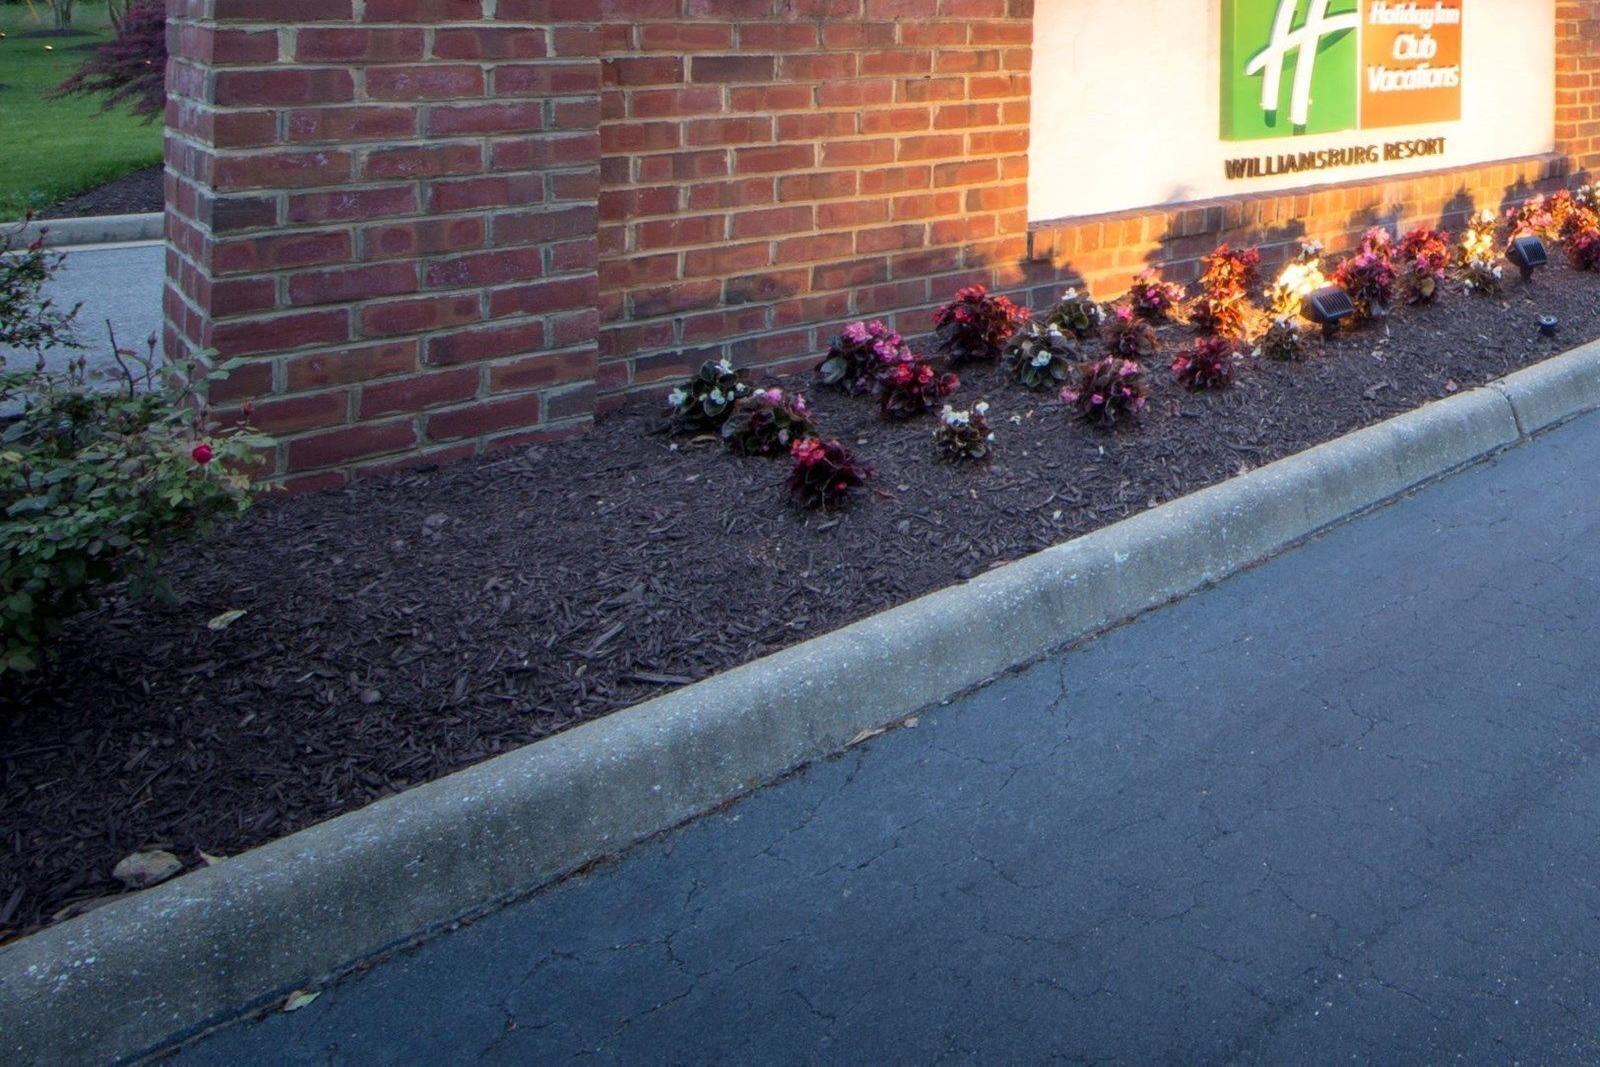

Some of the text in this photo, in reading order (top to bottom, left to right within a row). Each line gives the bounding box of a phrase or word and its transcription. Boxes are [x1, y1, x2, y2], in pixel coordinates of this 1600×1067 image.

[1369, 0, 1460, 30] Holiday Inn
[1392, 33, 1437, 60] Club
[1367, 64, 1459, 92] Vacations
[1225, 137, 1446, 180] WILLIAMSBURG RESORT
